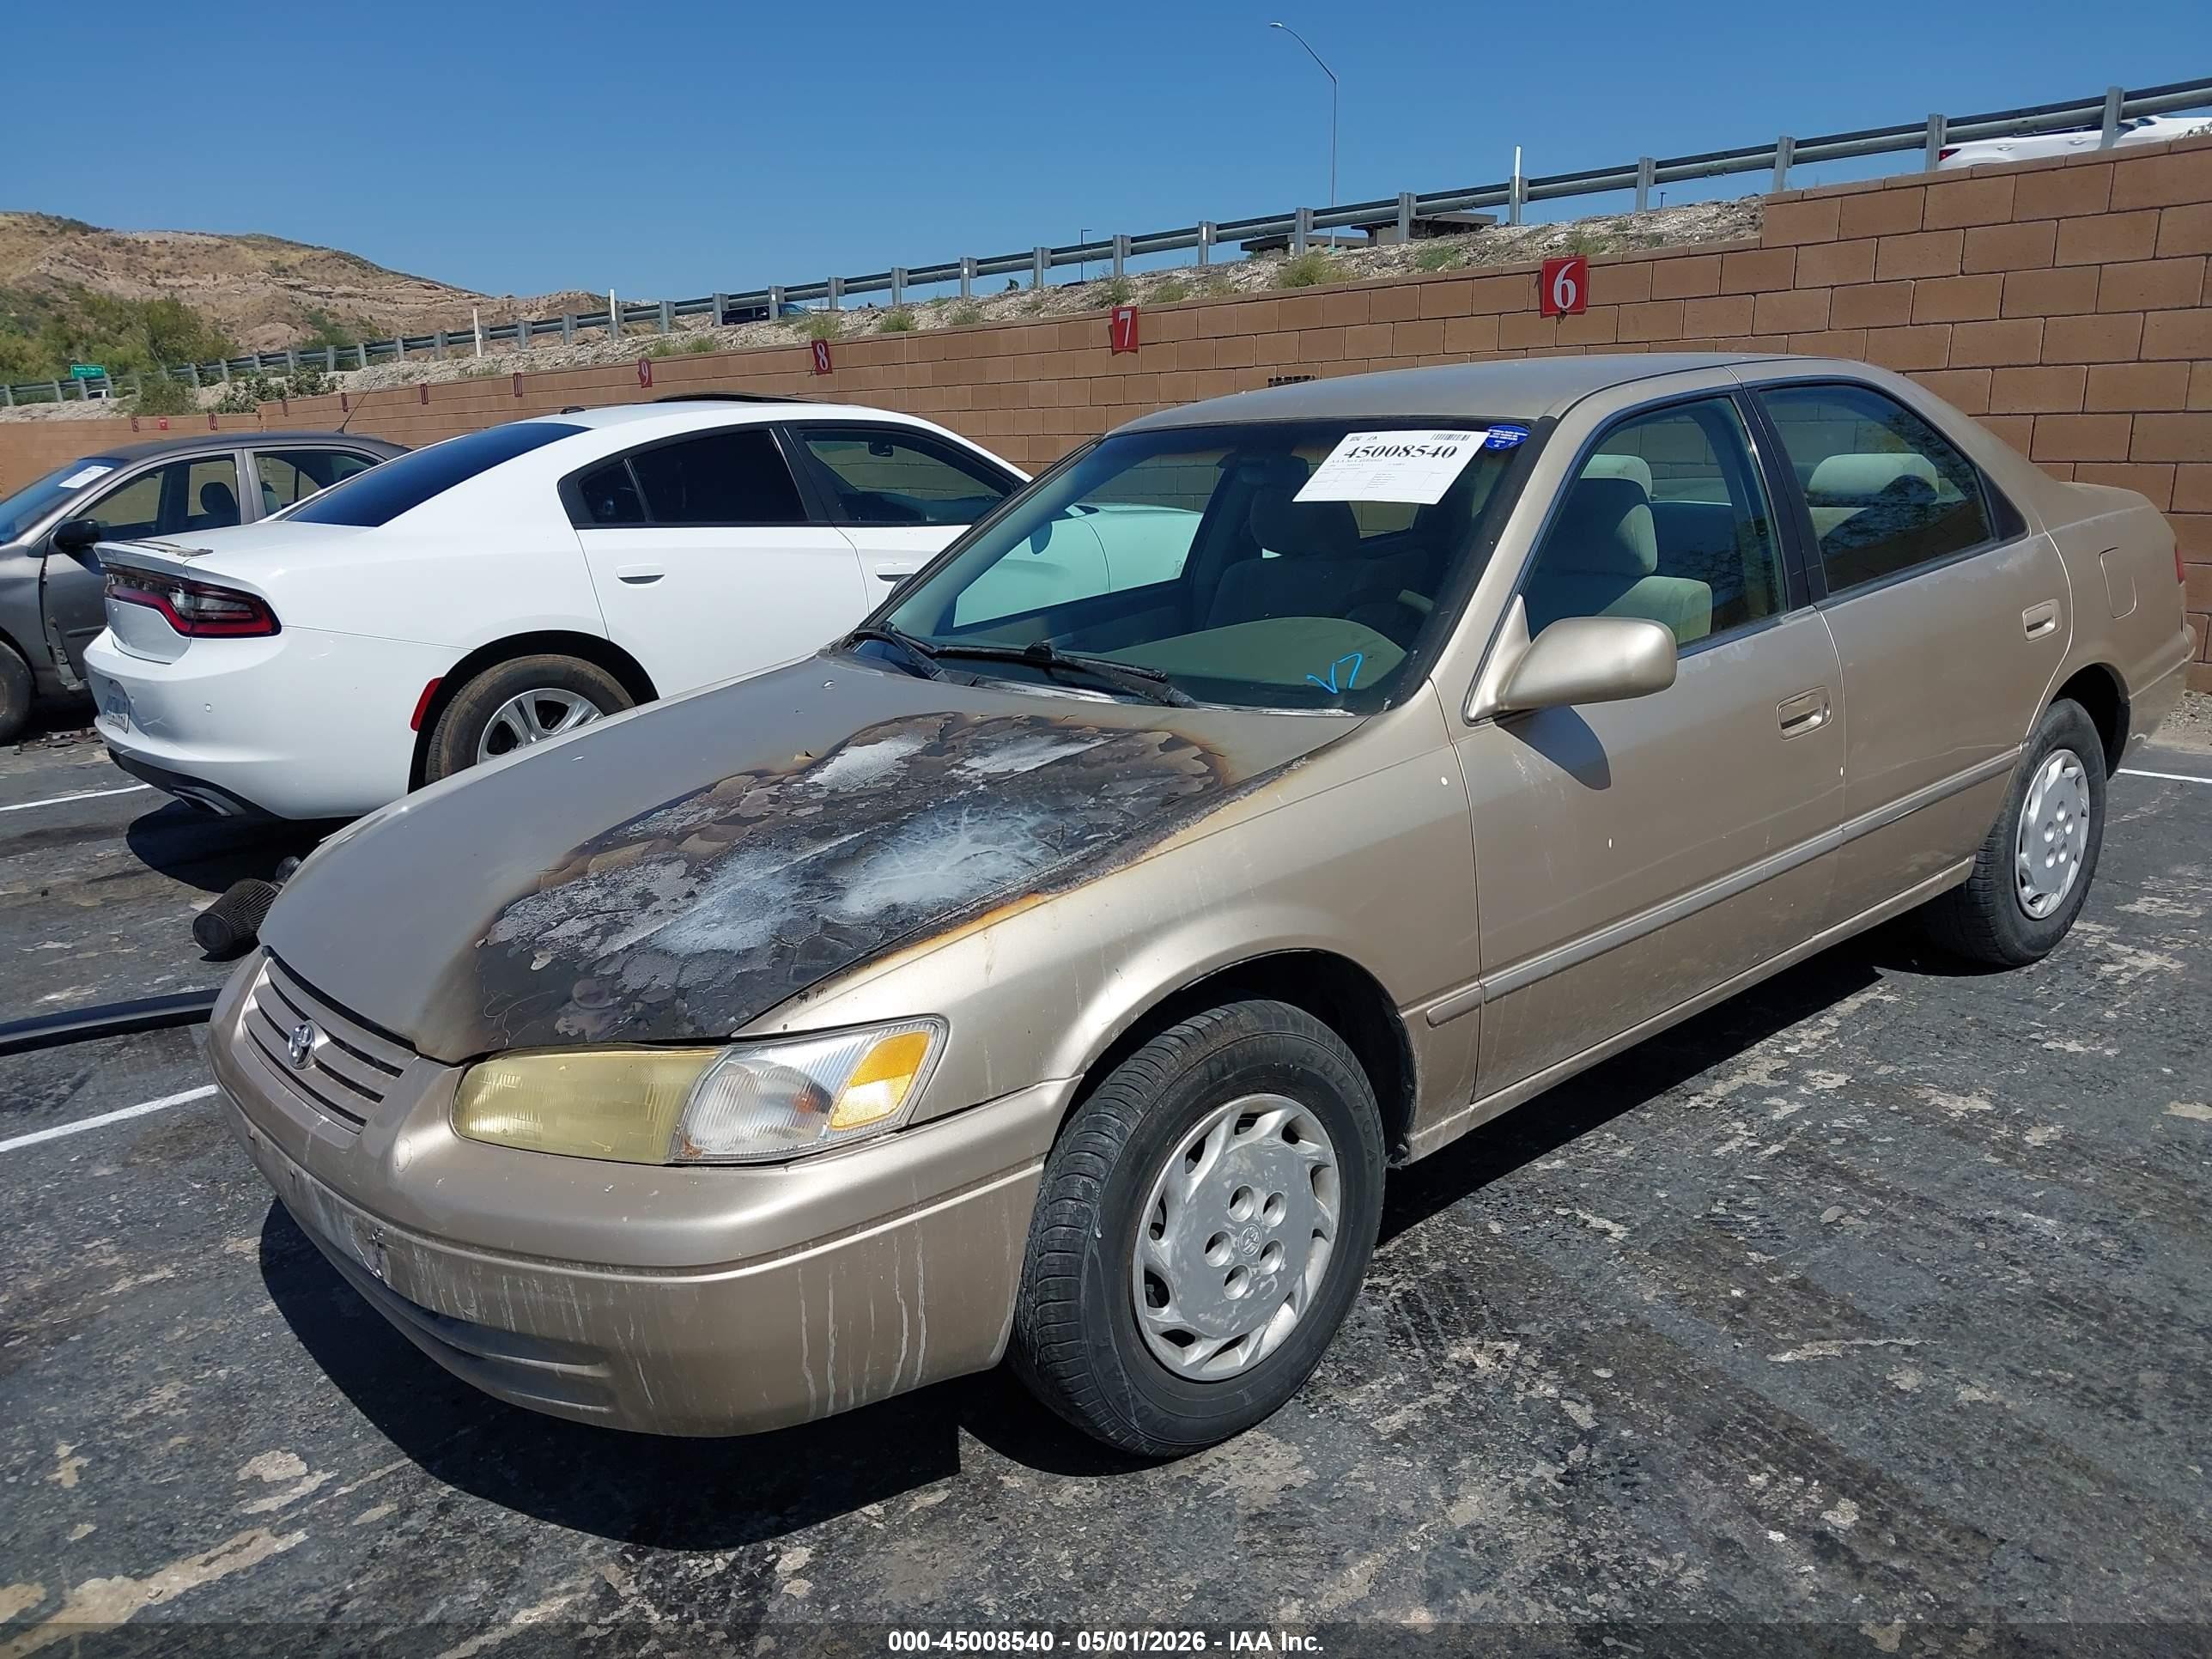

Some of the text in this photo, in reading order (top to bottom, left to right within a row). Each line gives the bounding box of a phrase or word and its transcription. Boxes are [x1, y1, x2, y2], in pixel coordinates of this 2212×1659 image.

[1553, 261, 1577, 309] 6
[1118, 310, 1133, 347] 7
[816, 343, 829, 371] 8
[641, 361, 649, 385] 9
[1343, 444, 1458, 459] 45008540
